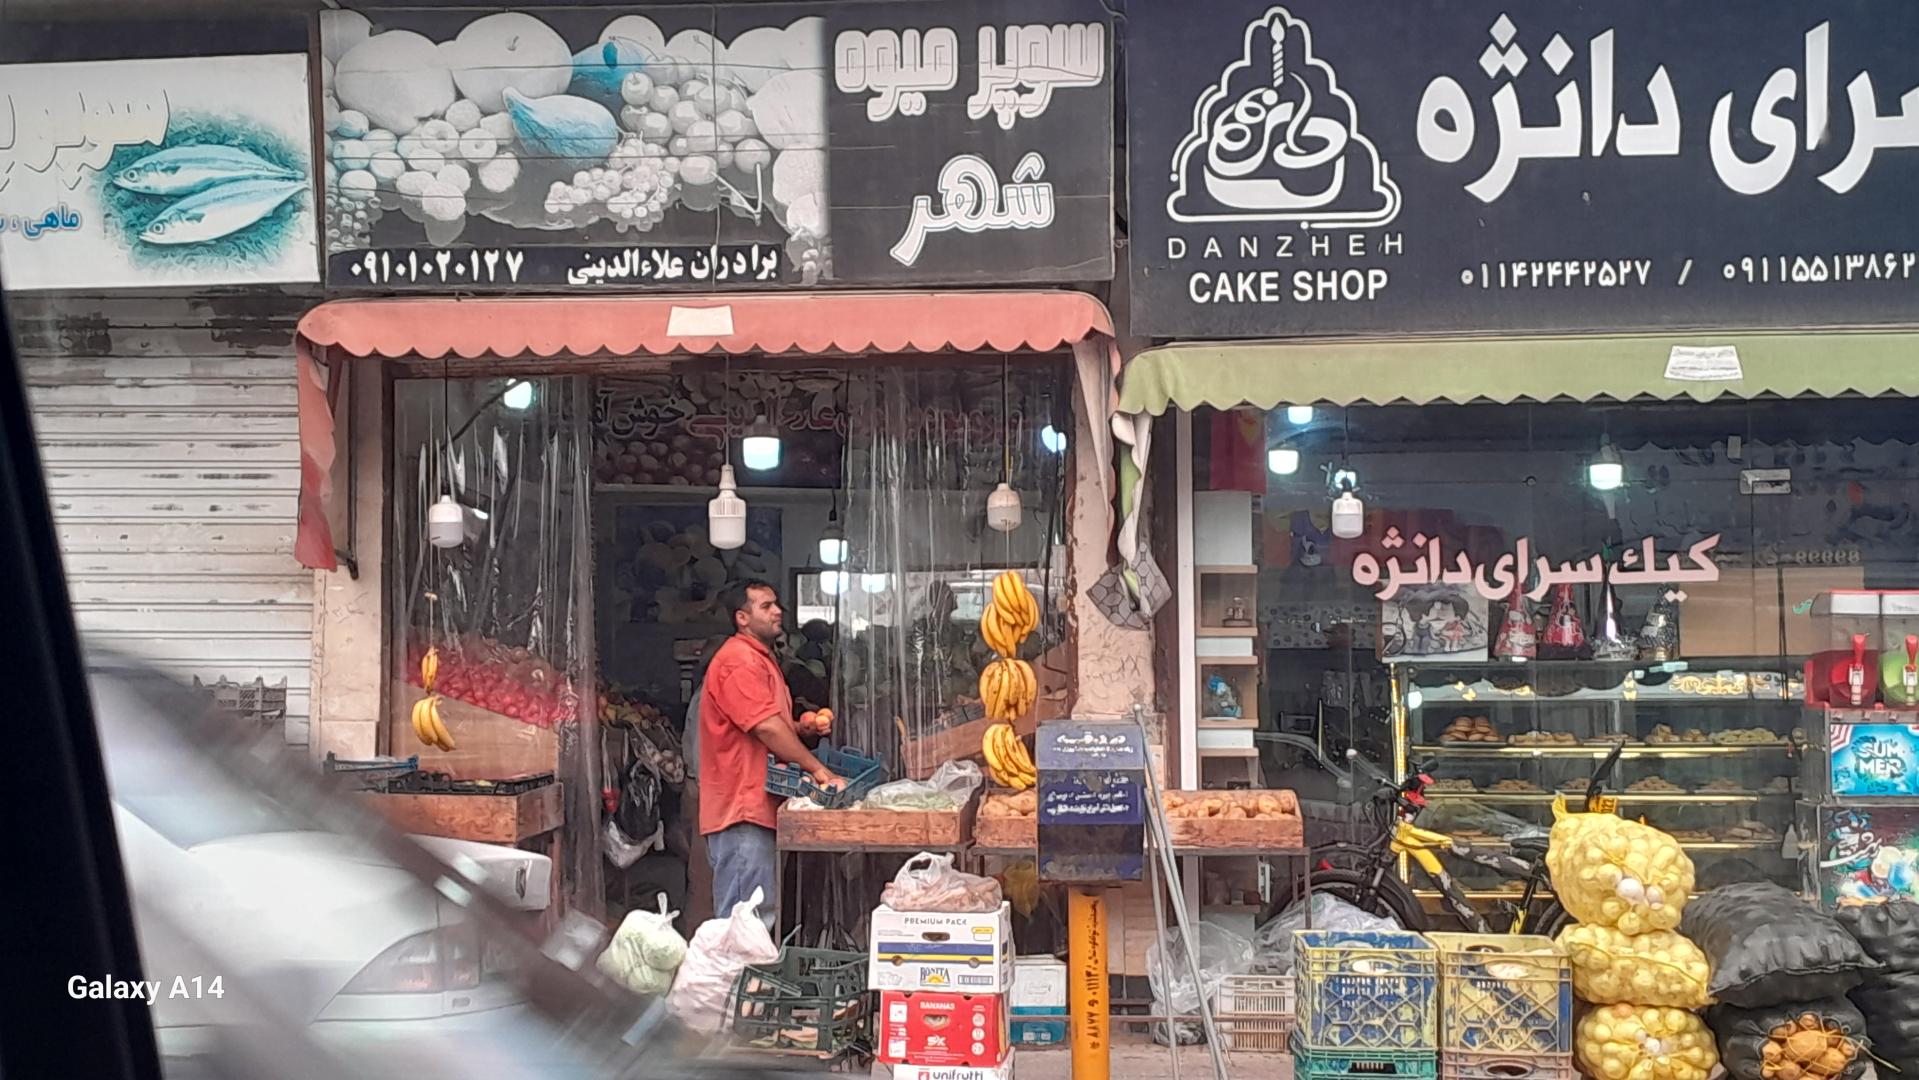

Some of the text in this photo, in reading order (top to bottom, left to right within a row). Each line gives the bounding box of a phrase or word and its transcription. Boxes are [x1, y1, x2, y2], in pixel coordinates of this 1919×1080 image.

[835, 23, 1104, 130] سوپر میوه
[1417, 13, 1919, 203] رای دانژه
[890, 152, 1054, 266] شهر
[1168, 234, 1403, 259] DANZHEH
[1189, 269, 1388, 303] CAKE SHOP
[1352, 526, 1472, 599] دانژه
[1475, 537, 1601, 600] سرای
